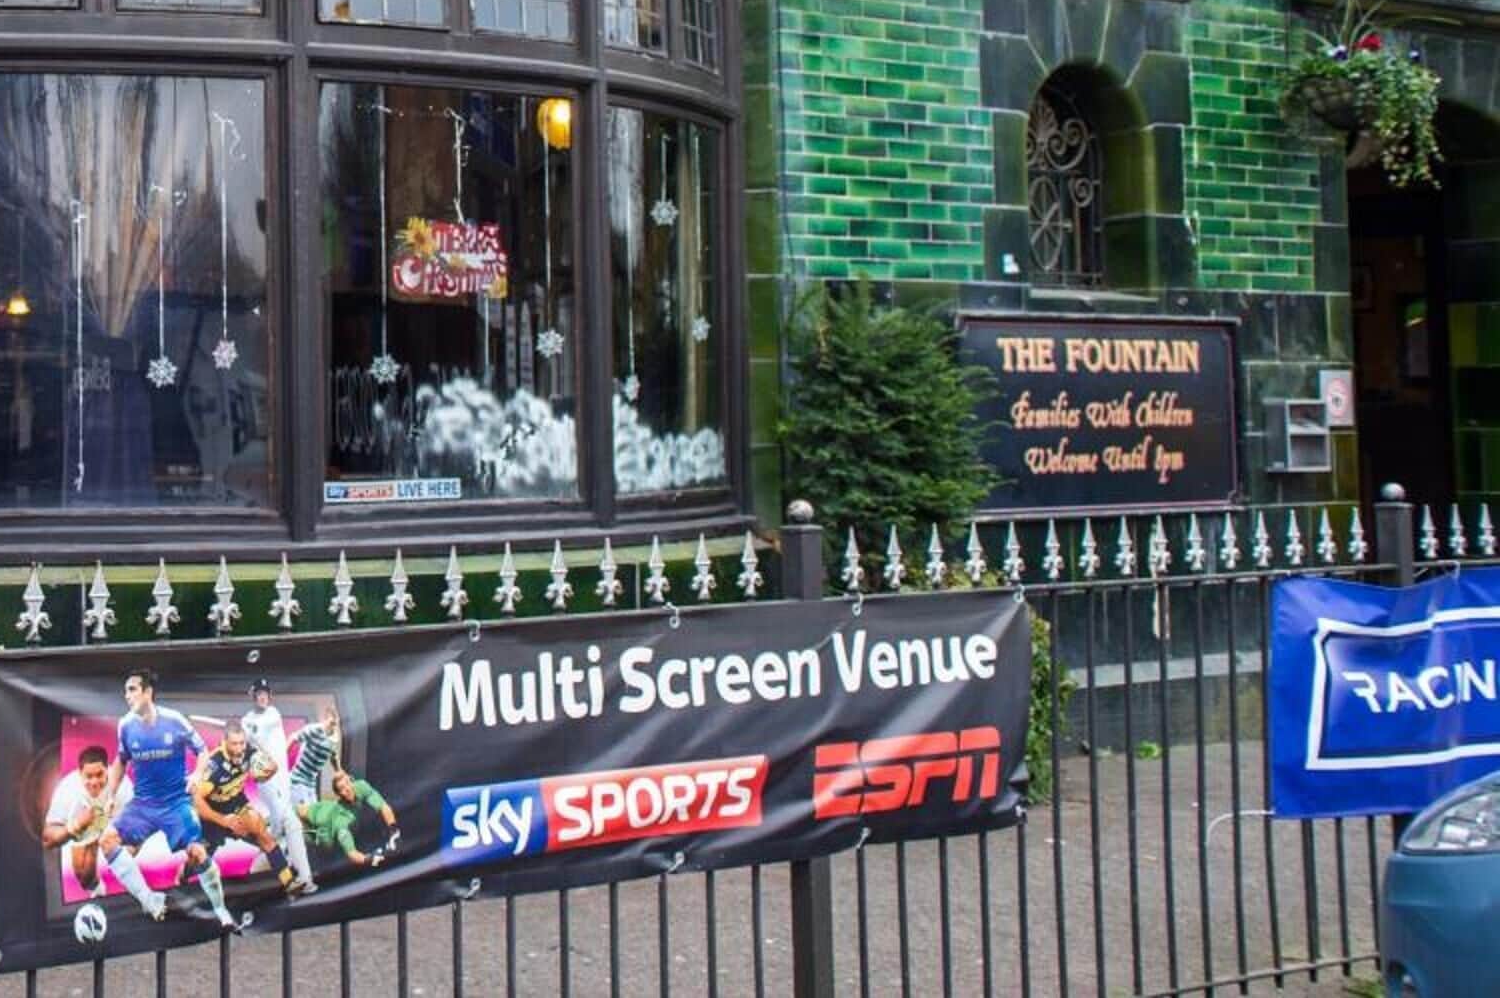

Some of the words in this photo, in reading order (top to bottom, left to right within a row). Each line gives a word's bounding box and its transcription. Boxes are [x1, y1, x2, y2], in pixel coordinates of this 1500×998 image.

[996, 337, 1057, 373] THE
[1065, 338, 1200, 374] FOUNTAIN
[1085, 390, 1134, 428] With
[1135, 390, 1194, 428] Children
[1024, 436, 1099, 474] Welcome
[1102, 435, 1153, 471] Until
[398, 481, 423, 498] LIVE
[428, 479, 458, 497] HERE
[438, 645, 602, 731] Multi
[619, 646, 820, 713] Screen
[831, 629, 998, 694] Venue
[451, 787, 534, 856] sky
[553, 767, 758, 842] SPORTS
[813, 726, 1000, 820] ESPN
